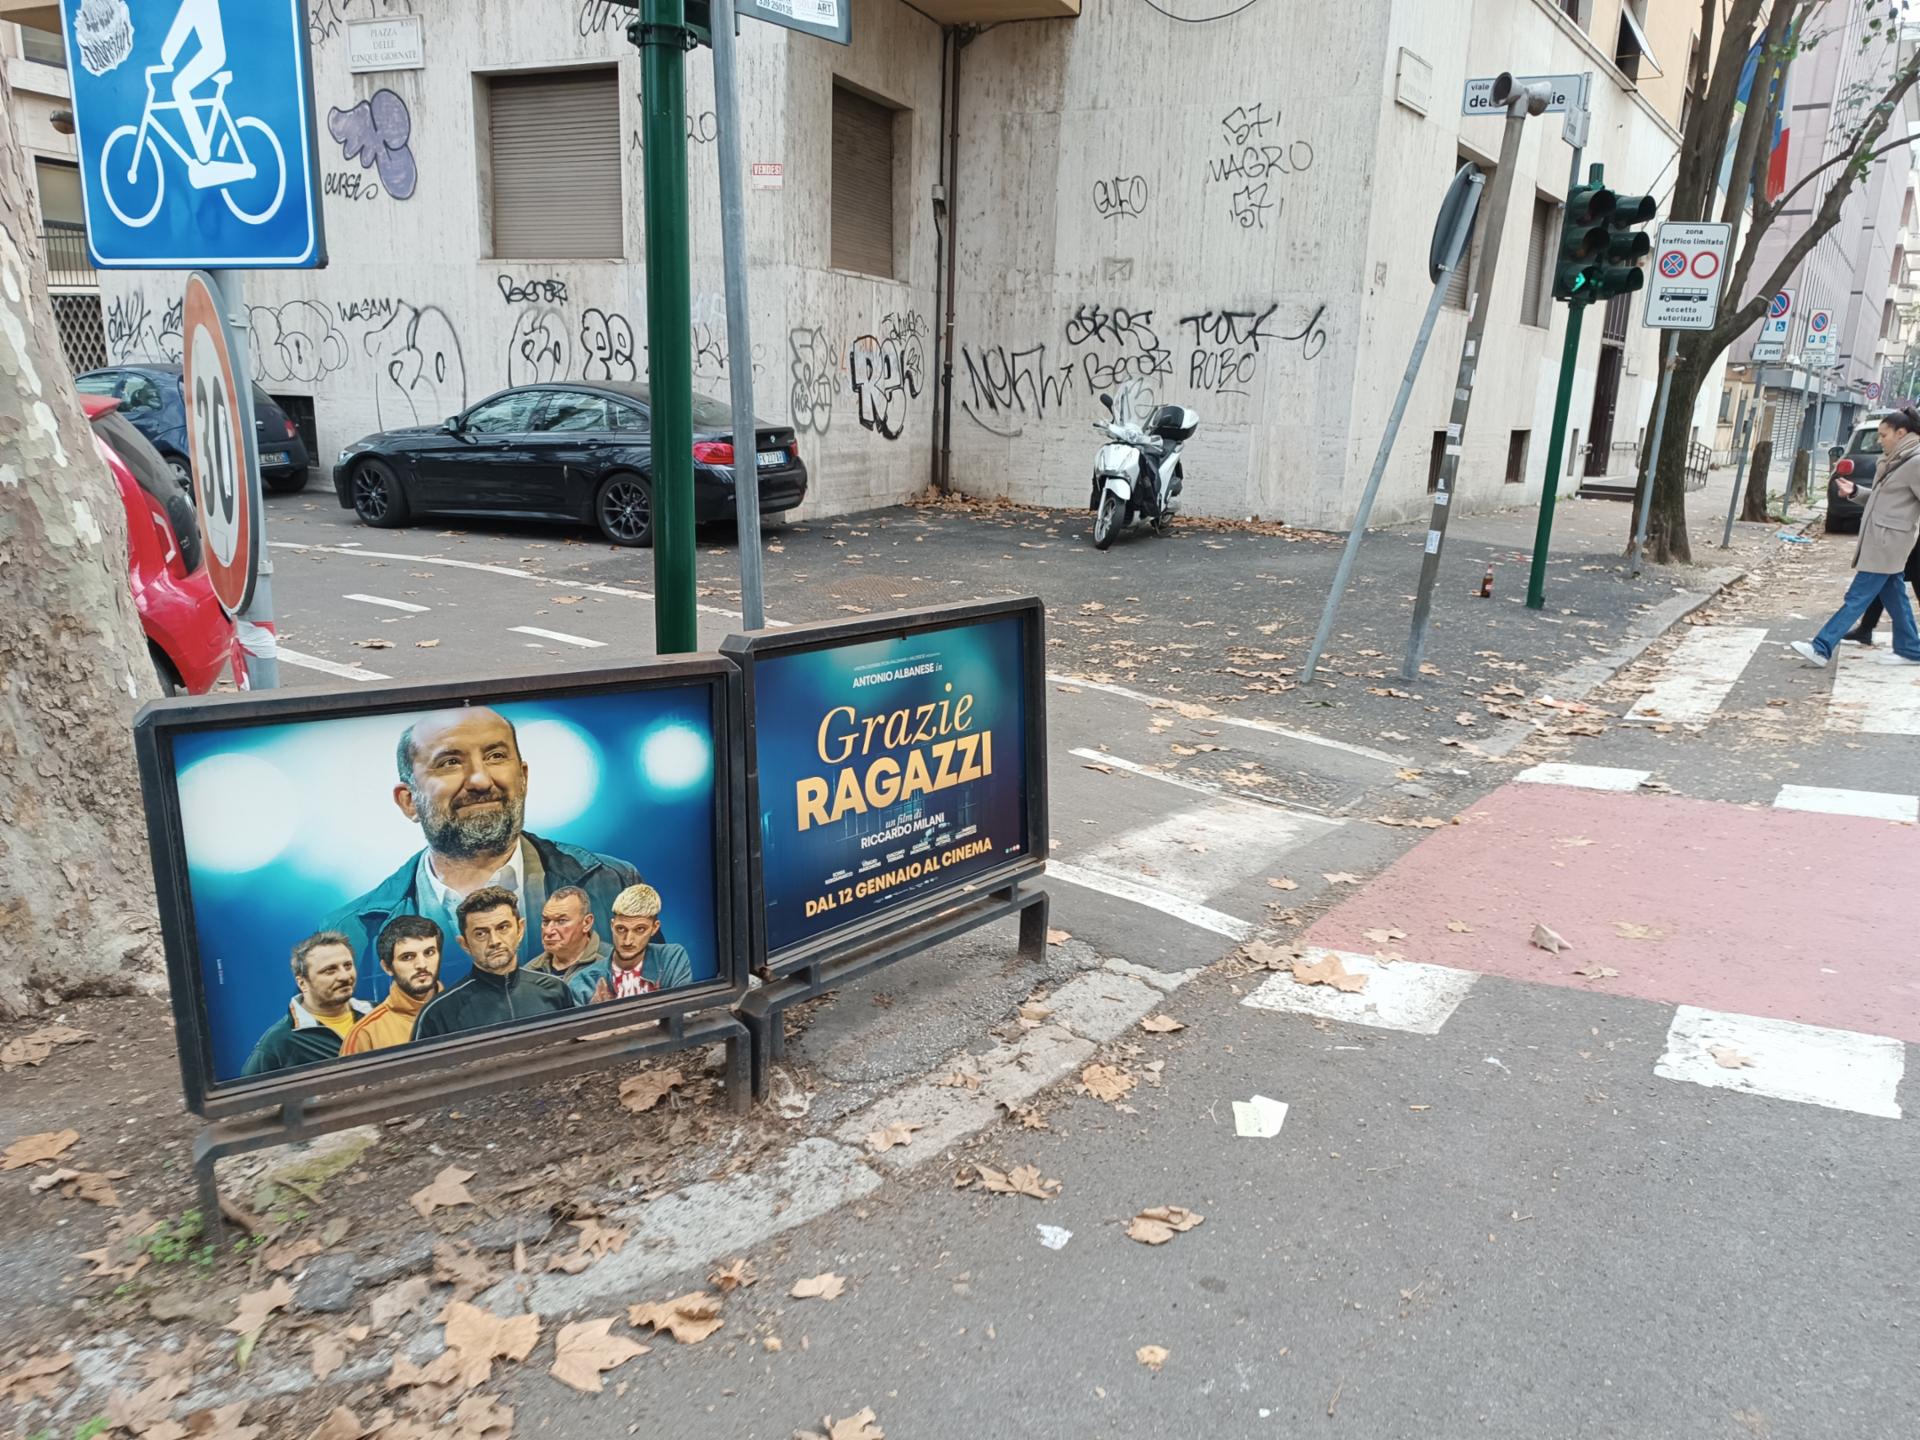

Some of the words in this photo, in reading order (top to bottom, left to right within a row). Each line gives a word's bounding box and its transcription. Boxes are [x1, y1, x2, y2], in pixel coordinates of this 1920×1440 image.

[371, 27, 398, 38] PIAZZA
[373, 39, 395, 50] DELLE
[352, 54, 378, 64] CINQUE
[380, 49, 417, 60] GIORNATE
[1658, 315, 1702, 323] autorizzati
[197, 376, 234, 525] 30
[853, 671, 893, 689] ANTONIO
[894, 663, 935, 680] ALBANESE
[935, 662, 943, 672] in
[817, 682, 974, 764] Grazie
[796, 730, 993, 832] RAGAZZI
[861, 823, 912, 849] RICCARDO
[912, 812, 945, 832] MILANI
[885, 819, 896, 829] un
[897, 813, 913, 827] film
[914, 808, 922, 820] di
[805, 893, 837, 918] DAL
[838, 887, 853, 905] 12
[855, 862, 922, 898] GENNAIO
[923, 858, 941, 875] AL
[941, 837, 993, 867] CINEMA
